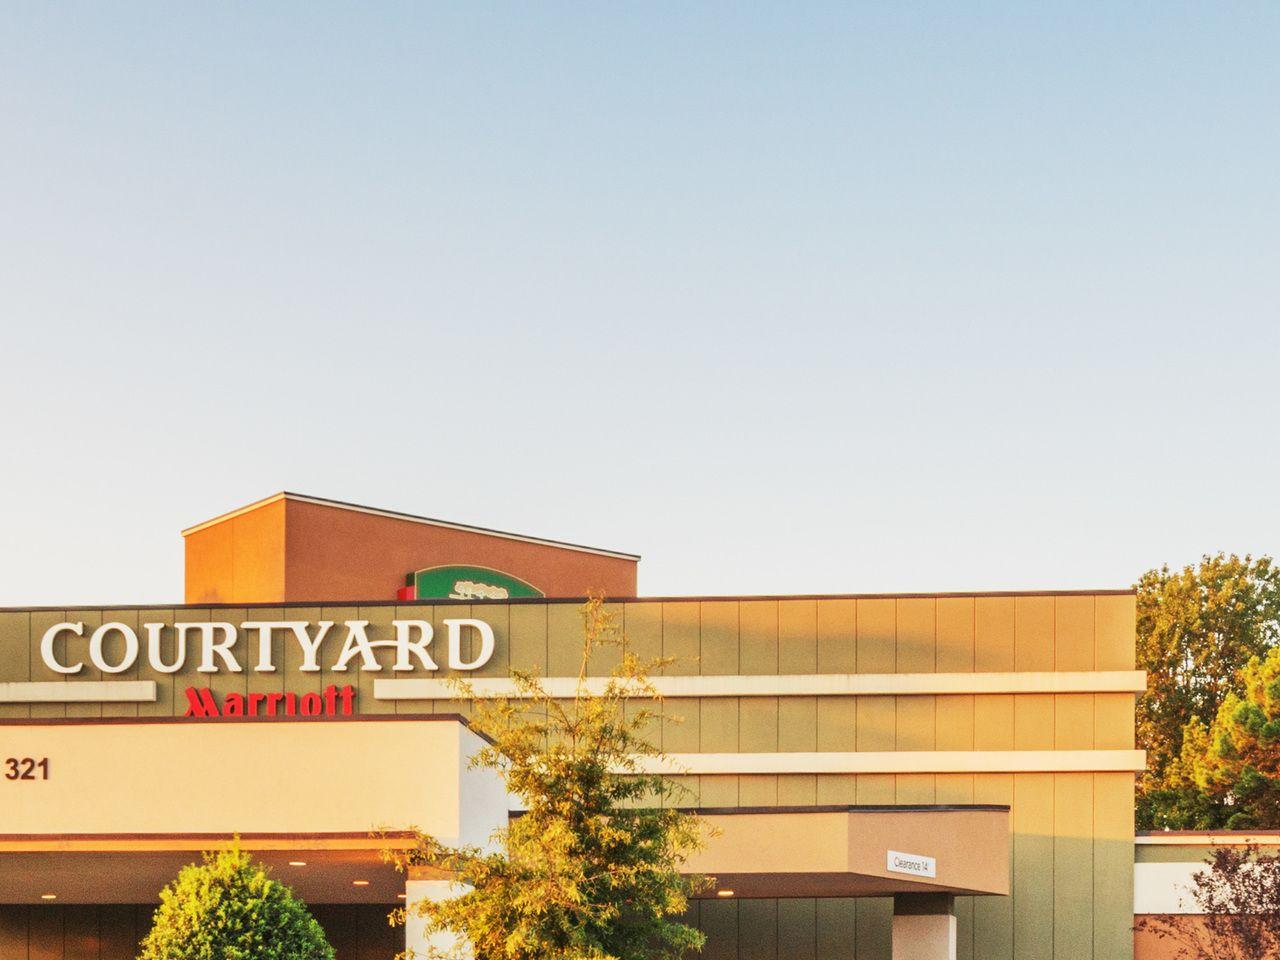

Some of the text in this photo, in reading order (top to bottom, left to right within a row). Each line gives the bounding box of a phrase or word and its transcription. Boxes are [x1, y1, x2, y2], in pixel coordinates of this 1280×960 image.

[40, 618, 495, 674] COURTYARD
[184, 683, 357, 718] Marriott
[5, 757, 48, 780] 321
[894, 856, 921, 871] Clearance
